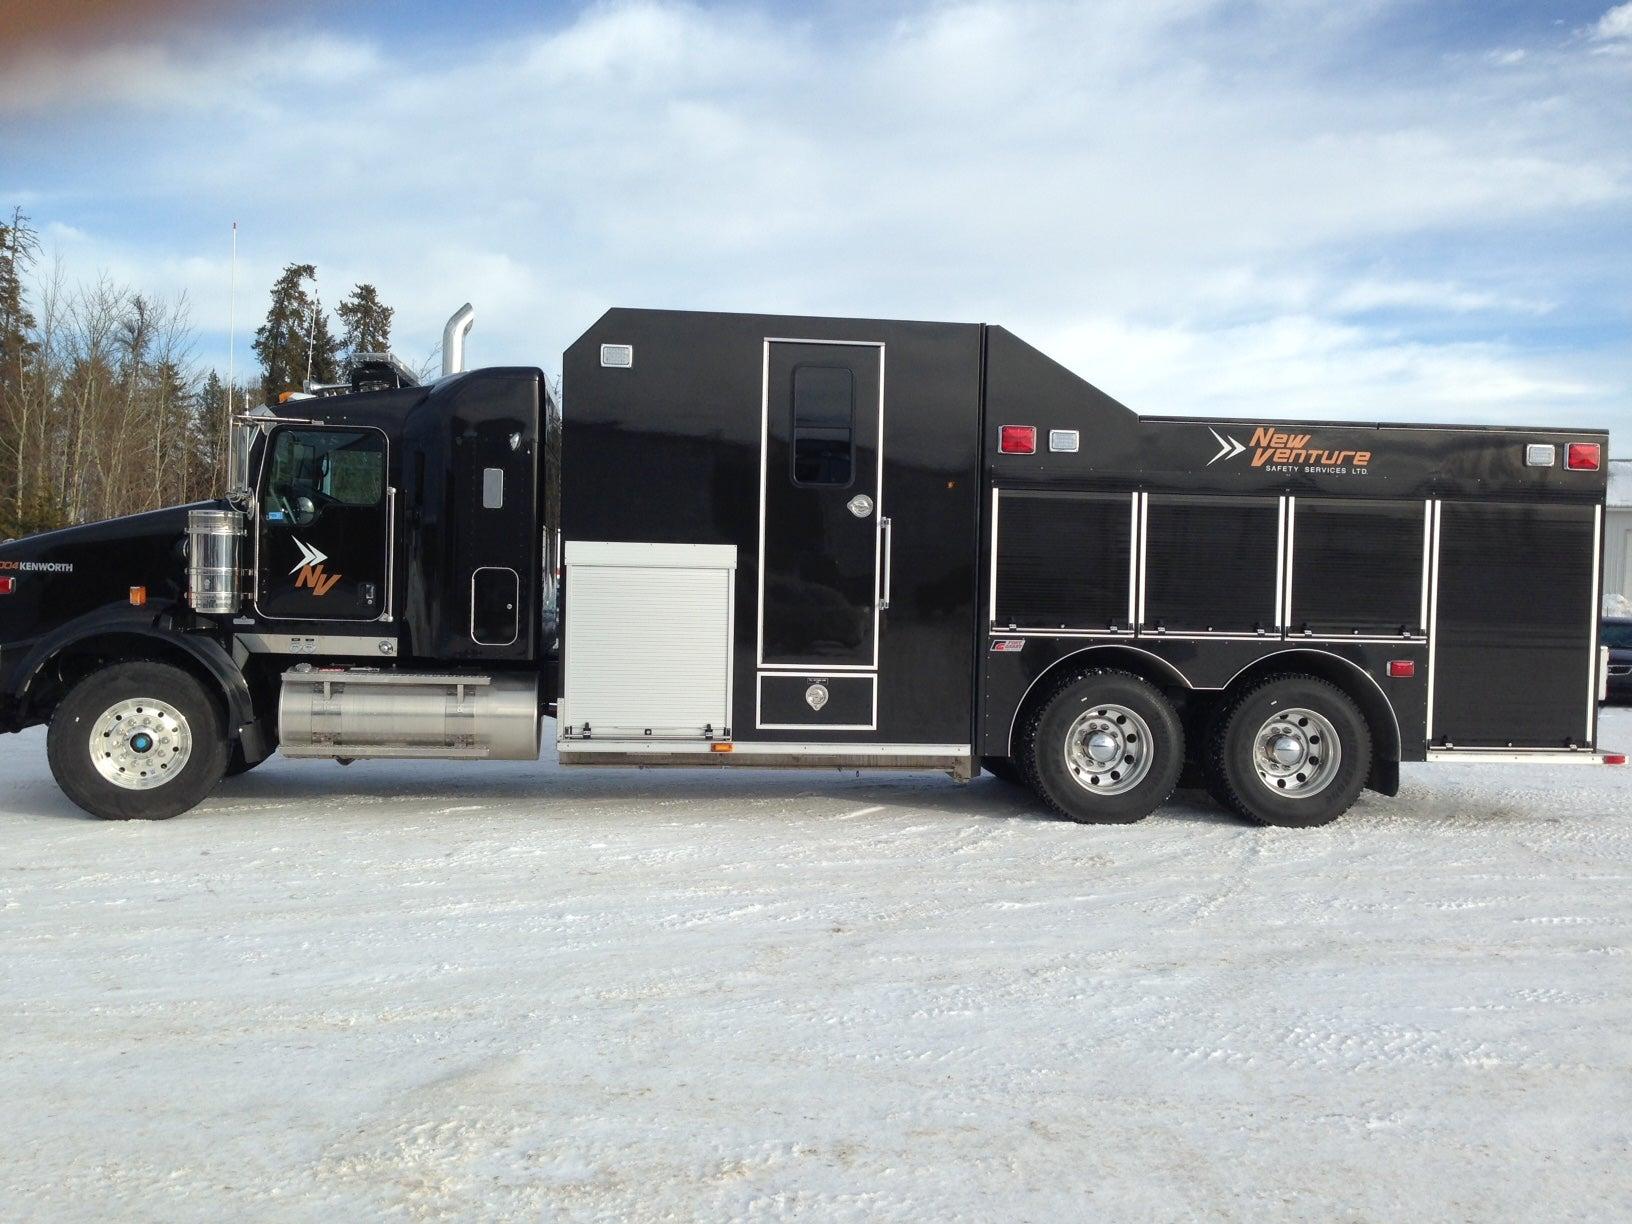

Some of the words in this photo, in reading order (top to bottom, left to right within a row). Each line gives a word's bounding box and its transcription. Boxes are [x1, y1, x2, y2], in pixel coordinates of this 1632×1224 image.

[1249, 427, 1311, 448] New
[1304, 466, 1347, 474] SERVICES
[19, 561, 73, 572] KENWORTH
[295, 564, 342, 596] NV
